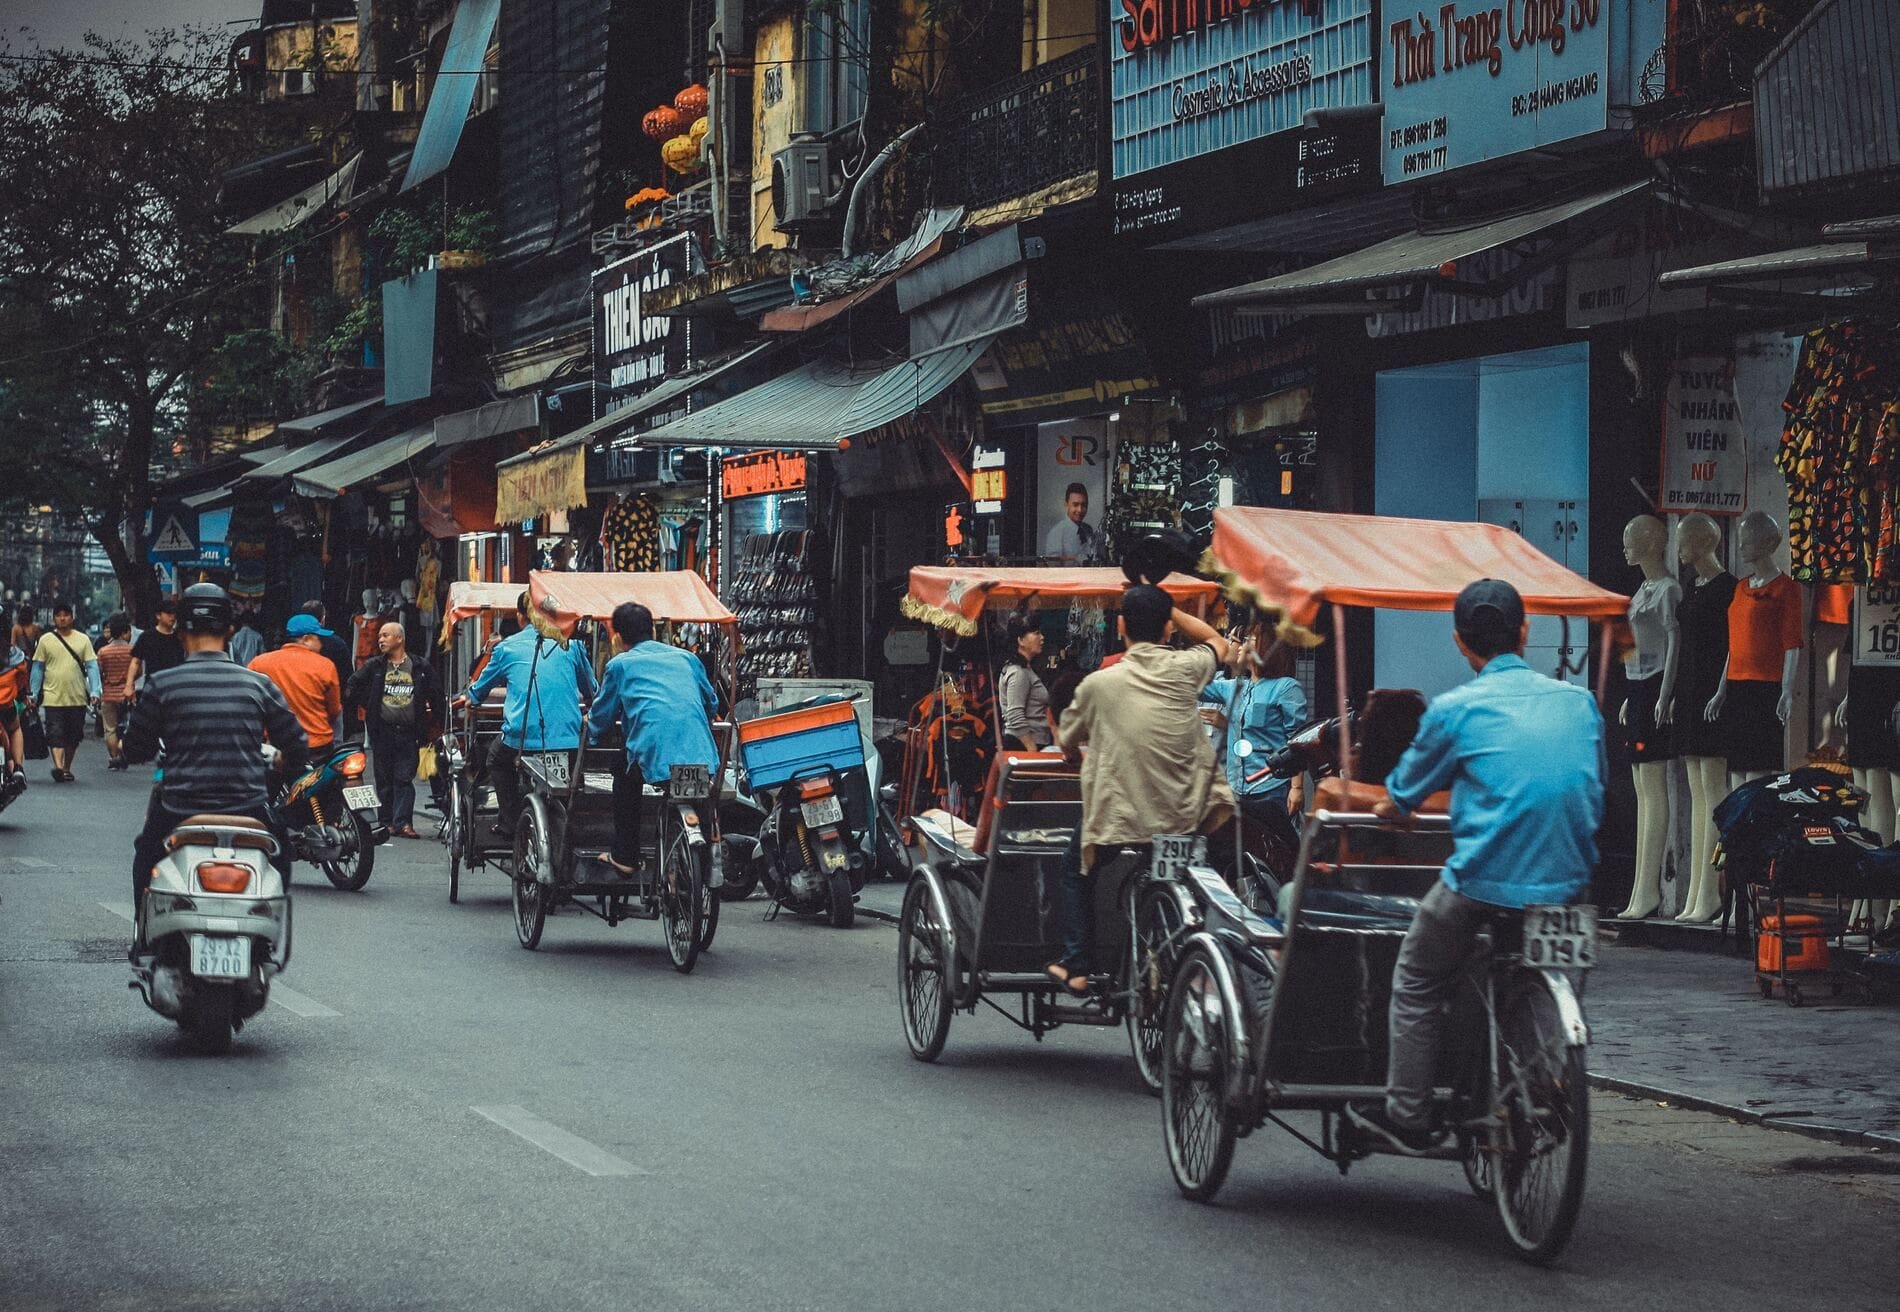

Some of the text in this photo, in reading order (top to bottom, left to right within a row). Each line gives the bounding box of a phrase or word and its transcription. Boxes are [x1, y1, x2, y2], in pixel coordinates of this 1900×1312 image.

[1440, 4, 1502, 76] Trang
[1172, 51, 1312, 120] Cosmetic & Accessories
[1539, 80, 1564, 108] HÀNG
[1564, 72, 1598, 100] NGANG
[1433, 146, 1447, 168] 777
[1680, 398, 1734, 421] NHÂN
[1685, 429, 1728, 451] VIÊN
[678, 767, 703, 782] 29XL
[1161, 840, 1196, 859] 29XL
[200, 957, 241, 974] 8700
